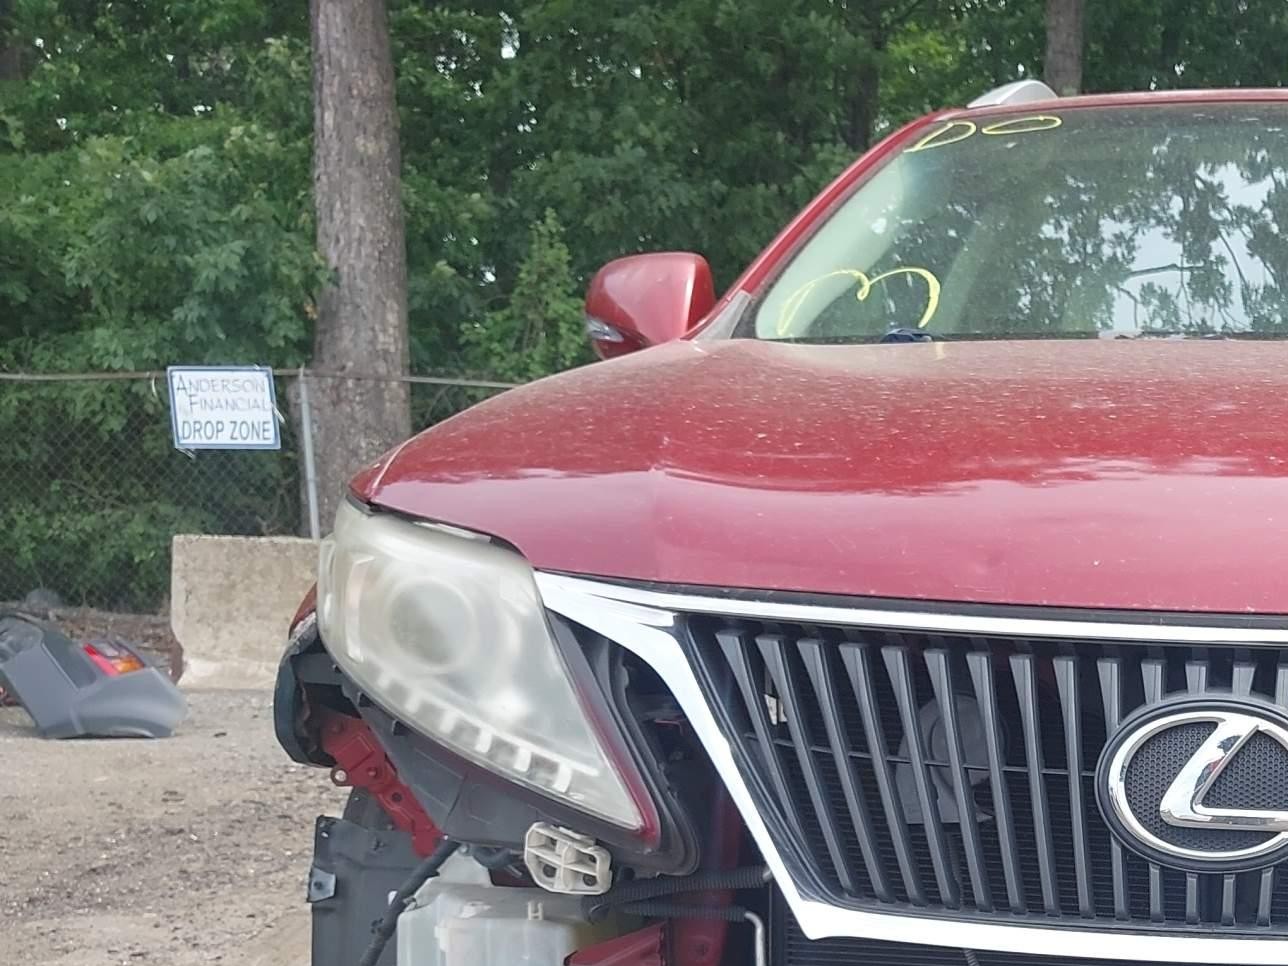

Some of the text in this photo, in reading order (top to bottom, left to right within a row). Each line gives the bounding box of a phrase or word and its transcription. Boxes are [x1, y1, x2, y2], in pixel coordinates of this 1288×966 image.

[177, 375, 264, 393] ANDERSON
[189, 394, 271, 413] FINANCIAL
[182, 421, 271, 440] DROP ZONE
